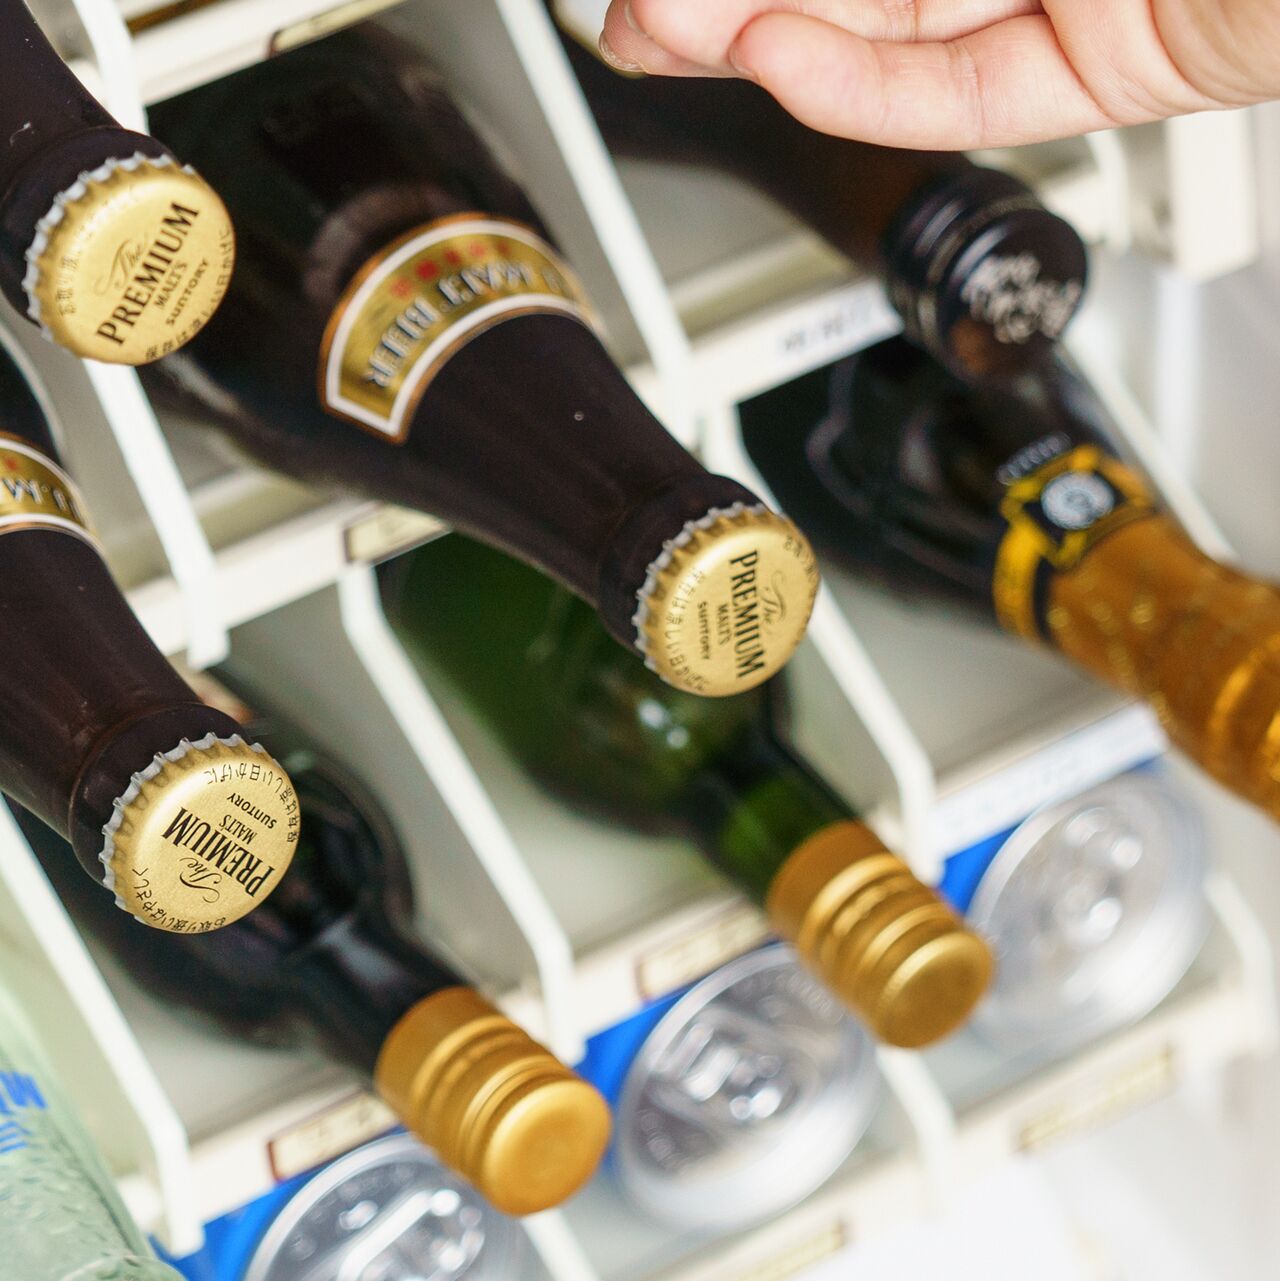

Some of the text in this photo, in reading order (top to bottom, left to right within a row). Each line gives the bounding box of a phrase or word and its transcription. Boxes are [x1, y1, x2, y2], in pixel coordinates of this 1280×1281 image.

[92, 234, 148, 297] The
[95, 200, 201, 347] PREMIUM
[165, 256, 210, 326] SUNTORY
[363, 296, 442, 389] BEER
[729, 549, 768, 679] PREMIUM
[219, 814, 258, 845] MALT'S
[227, 792, 278, 830] SUNTORY
[162, 806, 276, 898] PREMIUM
[178, 857, 222, 904] The
